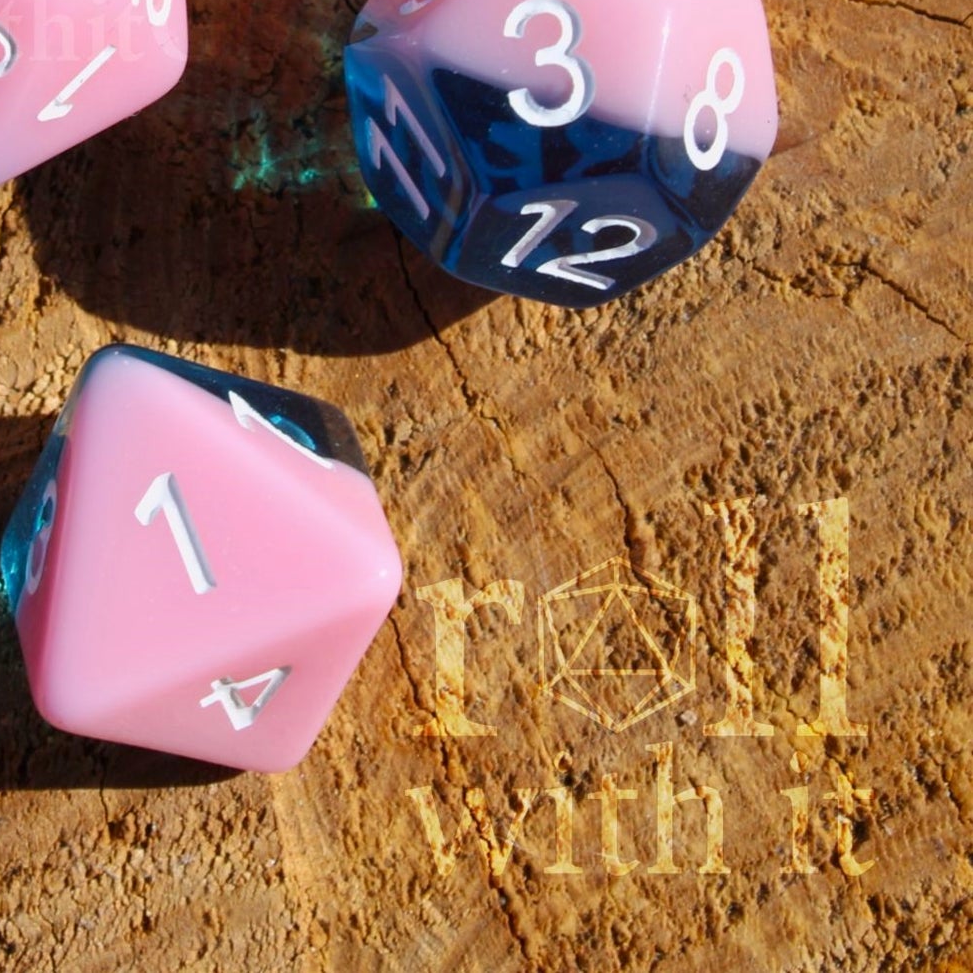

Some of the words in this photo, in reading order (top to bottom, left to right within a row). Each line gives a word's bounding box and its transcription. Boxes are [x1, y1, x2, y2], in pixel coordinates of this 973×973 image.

[365, 73, 446, 221] 11
[684, 48, 745, 170] 8
[501, 199, 658, 290] 12
[134, 472, 217, 594] 1
[200, 665, 291, 731] 4
